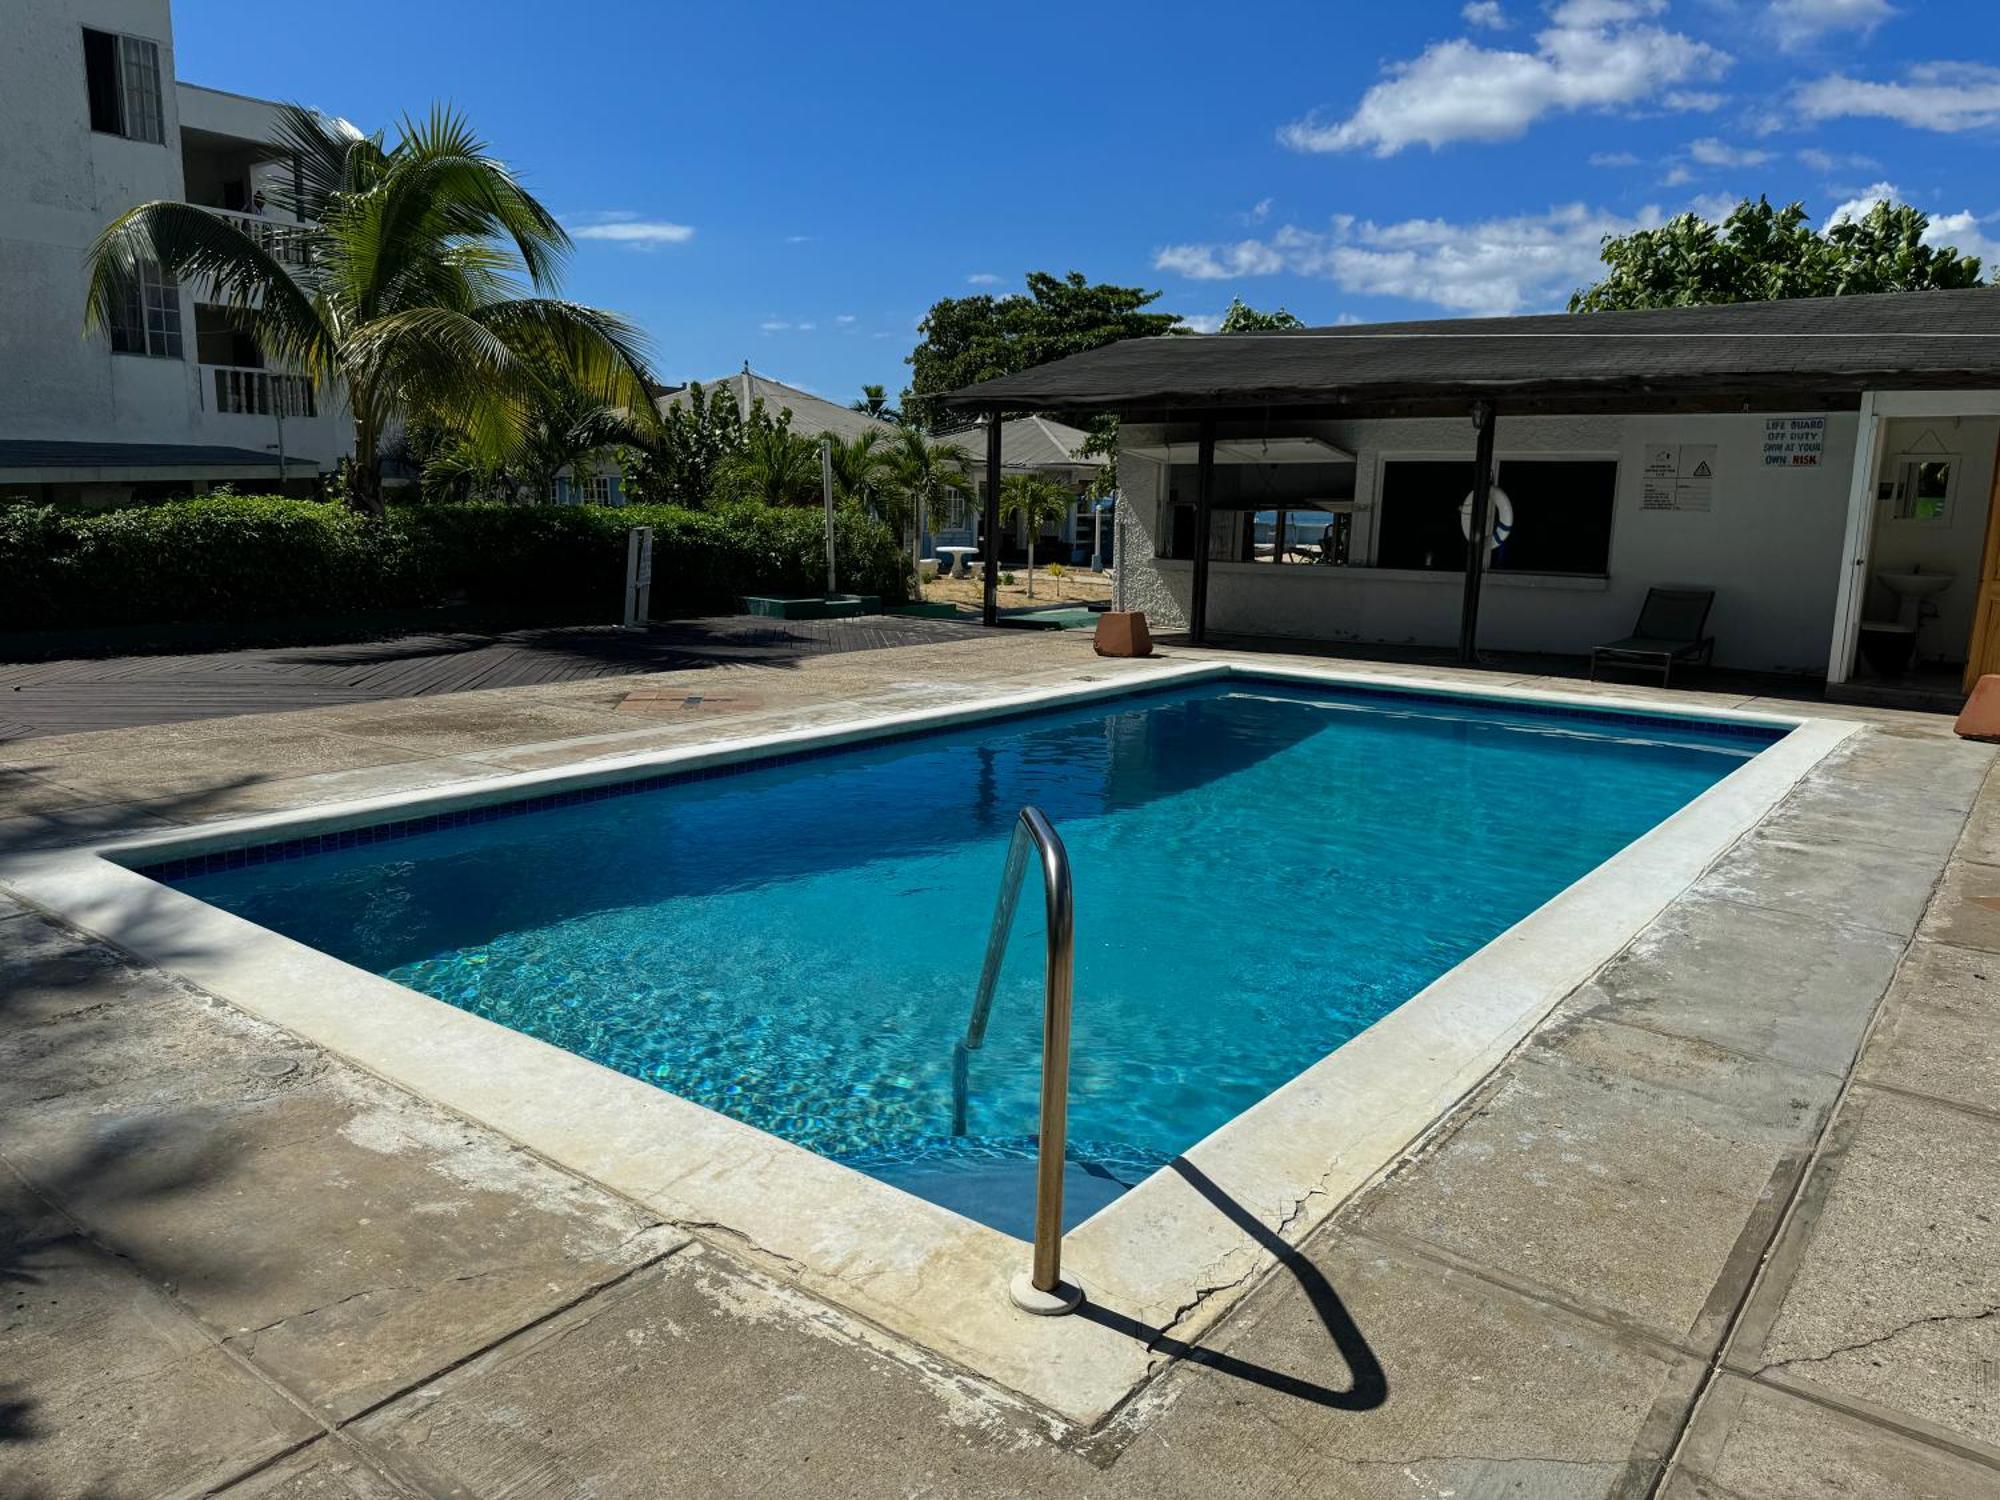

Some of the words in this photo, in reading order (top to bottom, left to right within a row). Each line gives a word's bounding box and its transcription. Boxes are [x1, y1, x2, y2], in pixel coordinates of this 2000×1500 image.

[1766, 421, 1785, 430] LIFE
[1791, 421, 1823, 430] GUARD
[1768, 432, 1786, 440] OFF
[1790, 432, 1818, 440] DUTY
[1785, 443, 1795, 451] AT
[1798, 443, 1821, 452] YOUR
[1765, 455, 1787, 464] OWN
[1792, 455, 1817, 464] RISK
